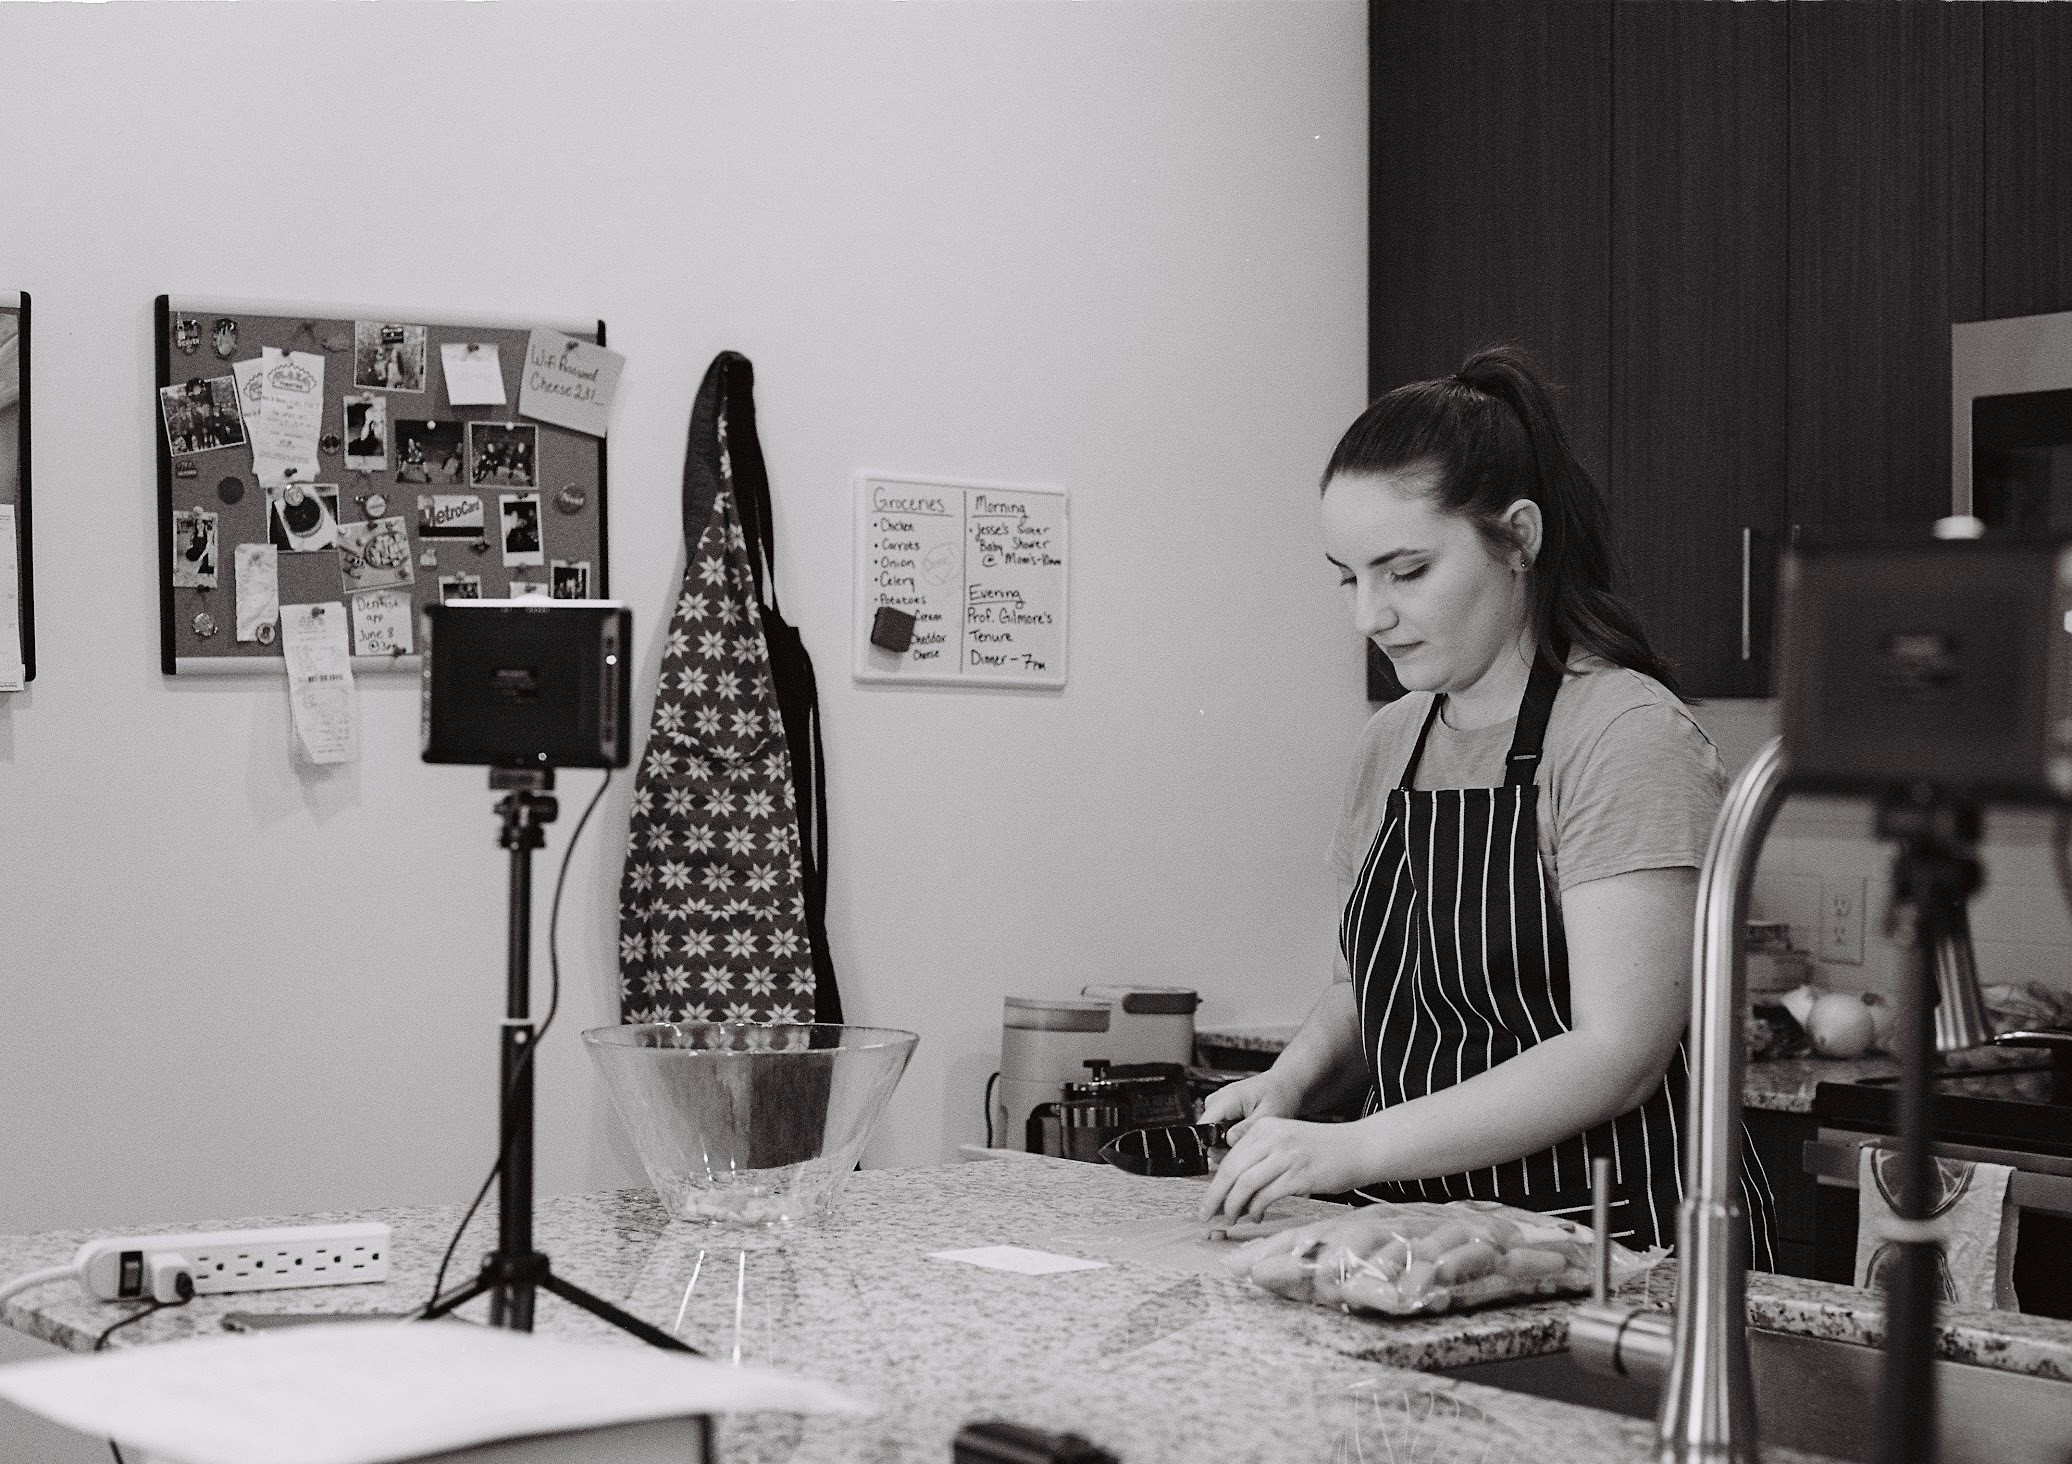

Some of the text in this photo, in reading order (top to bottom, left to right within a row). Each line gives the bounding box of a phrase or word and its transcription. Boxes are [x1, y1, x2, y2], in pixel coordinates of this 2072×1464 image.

[873, 486, 945, 512] Groceries
[975, 495, 1027, 520] Morning
[882, 538, 920, 551] Carrots
[979, 536, 1050, 556] Baby Shower
[880, 556, 916, 569] Onion
[880, 570, 915, 593] Celery
[880, 592, 926, 605] Potatoes
[968, 583, 1026, 609] Evening
[999, 607, 1052, 624] Gilmore's
[360, 628, 382, 642] June
[968, 629, 1013, 643] Tenure
